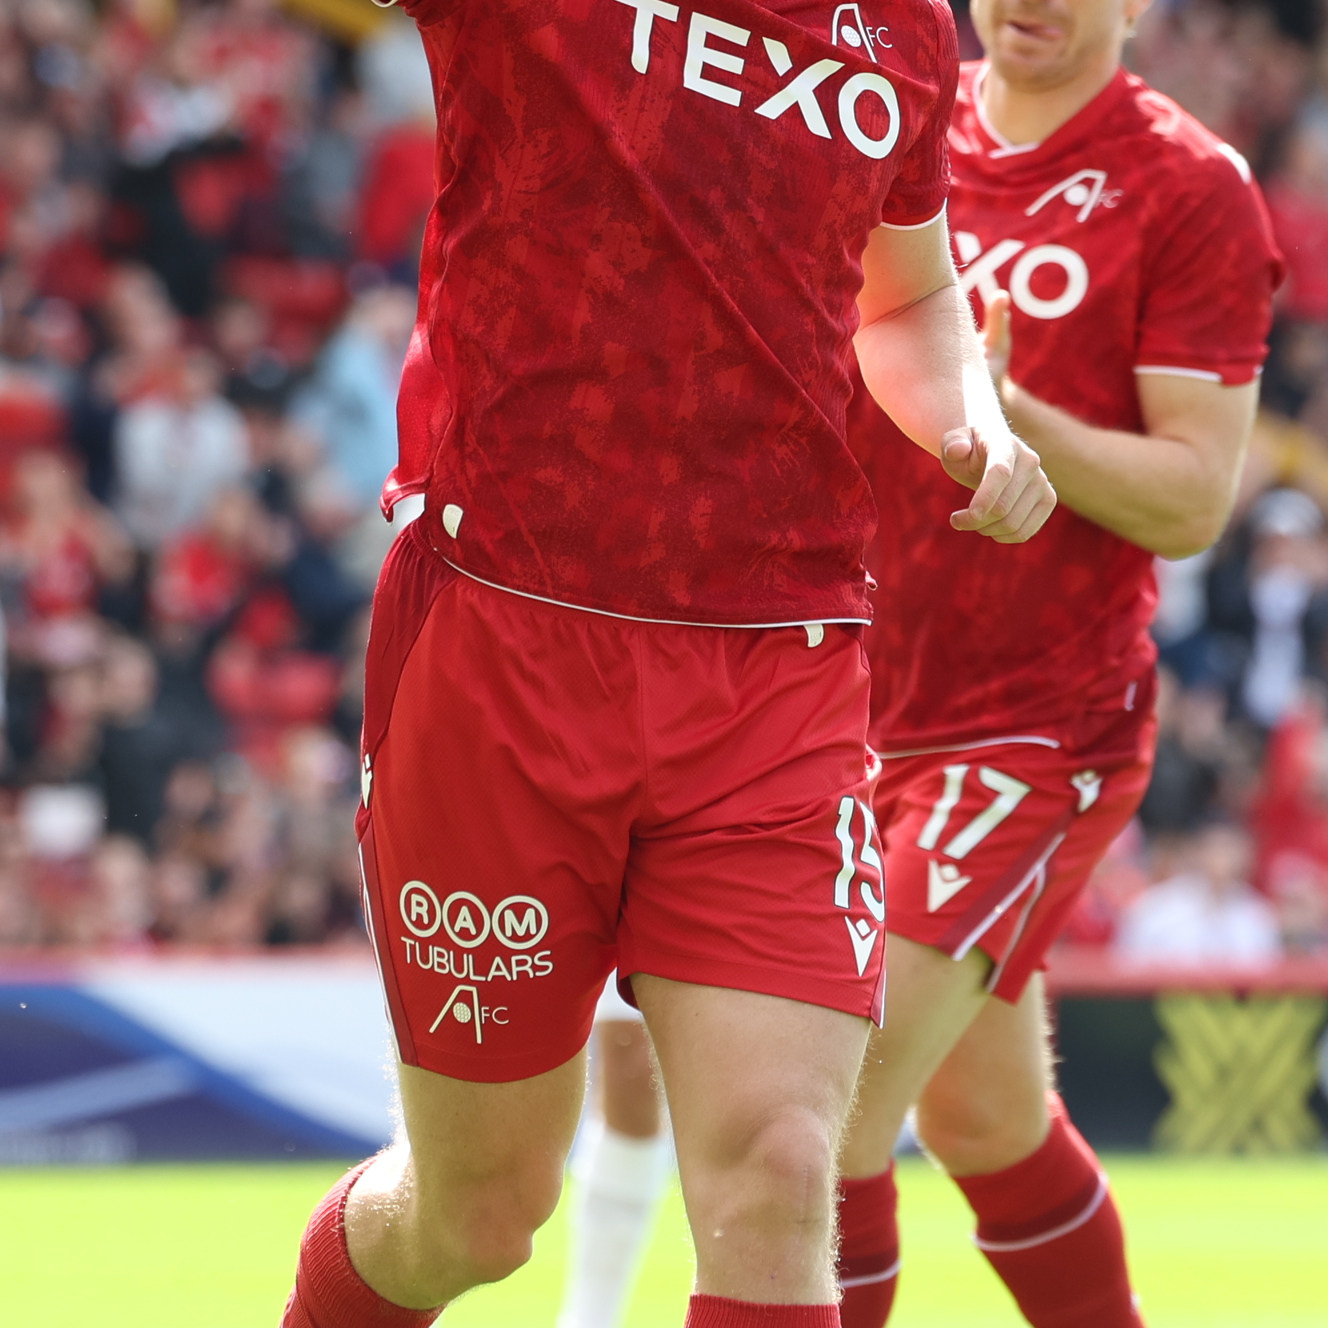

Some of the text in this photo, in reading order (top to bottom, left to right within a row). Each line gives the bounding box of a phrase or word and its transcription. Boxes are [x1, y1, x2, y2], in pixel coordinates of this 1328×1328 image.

[954, 230, 1090, 320] XO
[916, 763, 1033, 860] 17
[833, 795, 885, 923] 15
[400, 935, 555, 982] TUBULARS
[405, 885, 544, 944] RAM
